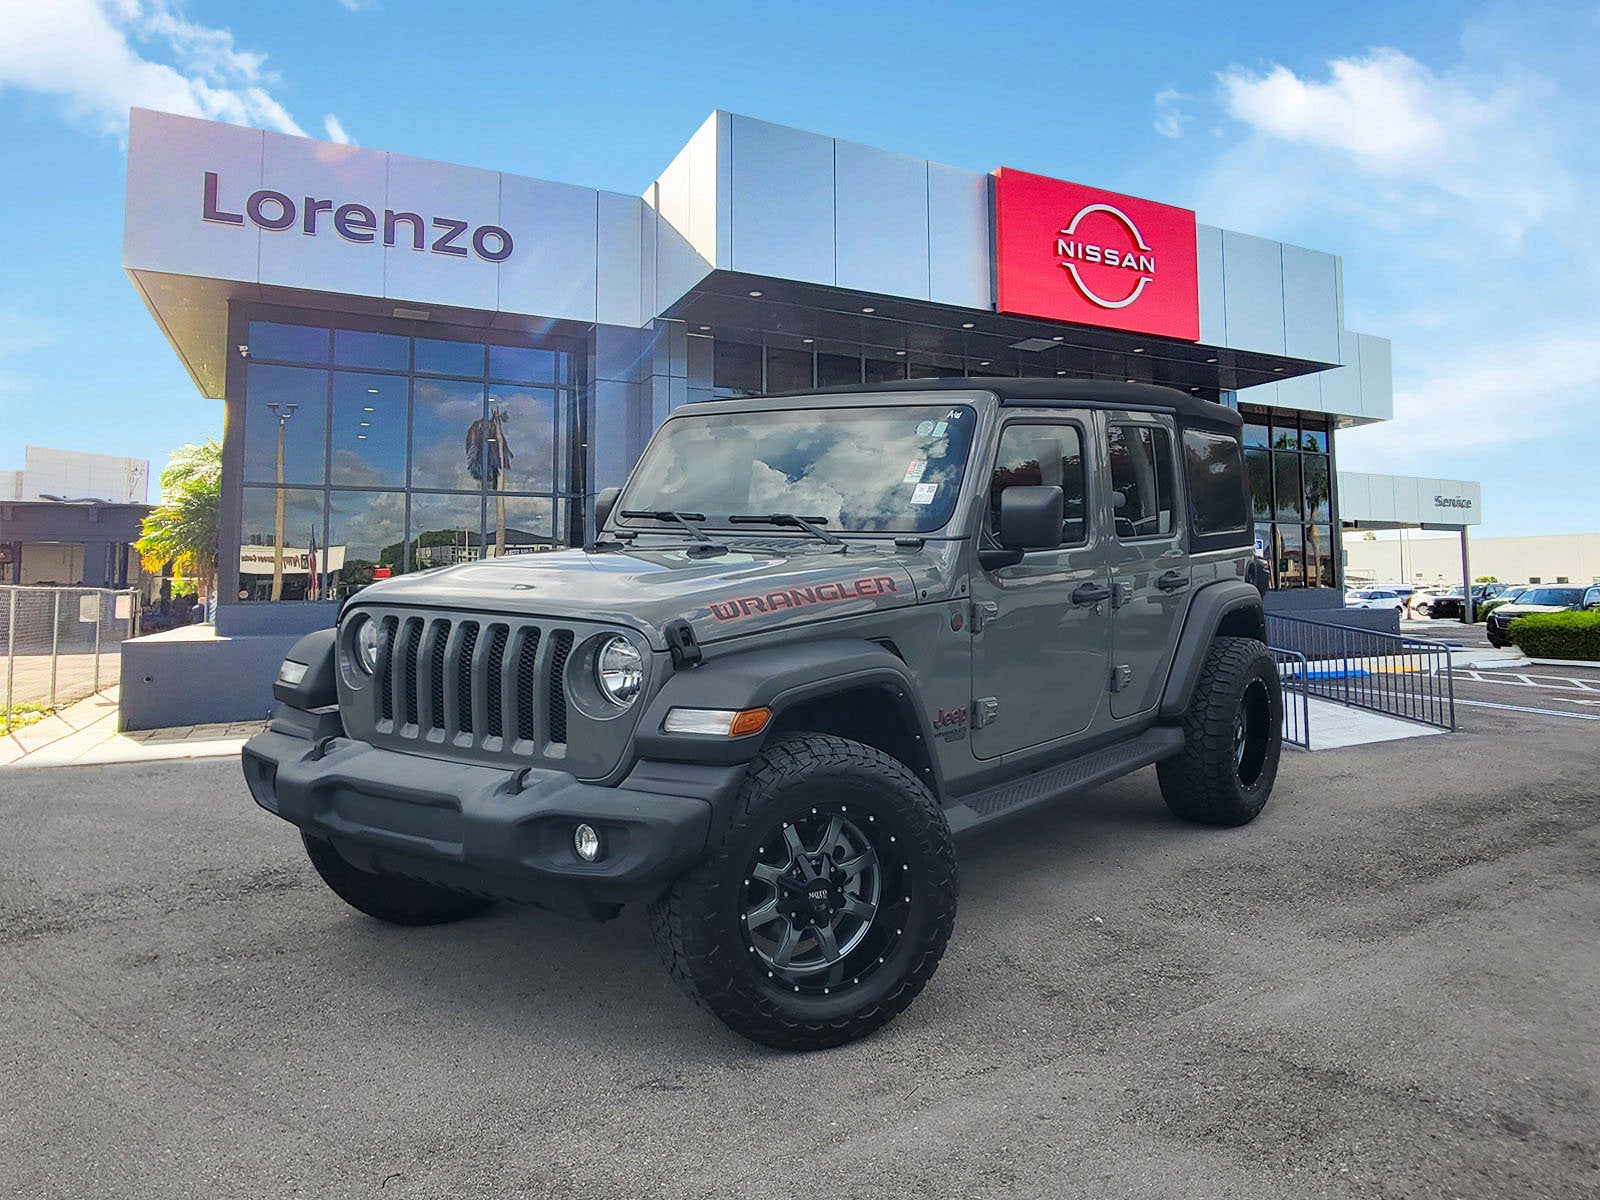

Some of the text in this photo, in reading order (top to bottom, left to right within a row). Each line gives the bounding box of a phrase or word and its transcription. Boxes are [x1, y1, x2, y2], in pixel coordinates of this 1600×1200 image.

[202, 171, 514, 263] Lorenzo
[1057, 238, 1155, 273] NISSAN
[1434, 495, 1472, 508] Service
[709, 576, 899, 622] WRANGLER
[933, 706, 967, 729] Jeep
